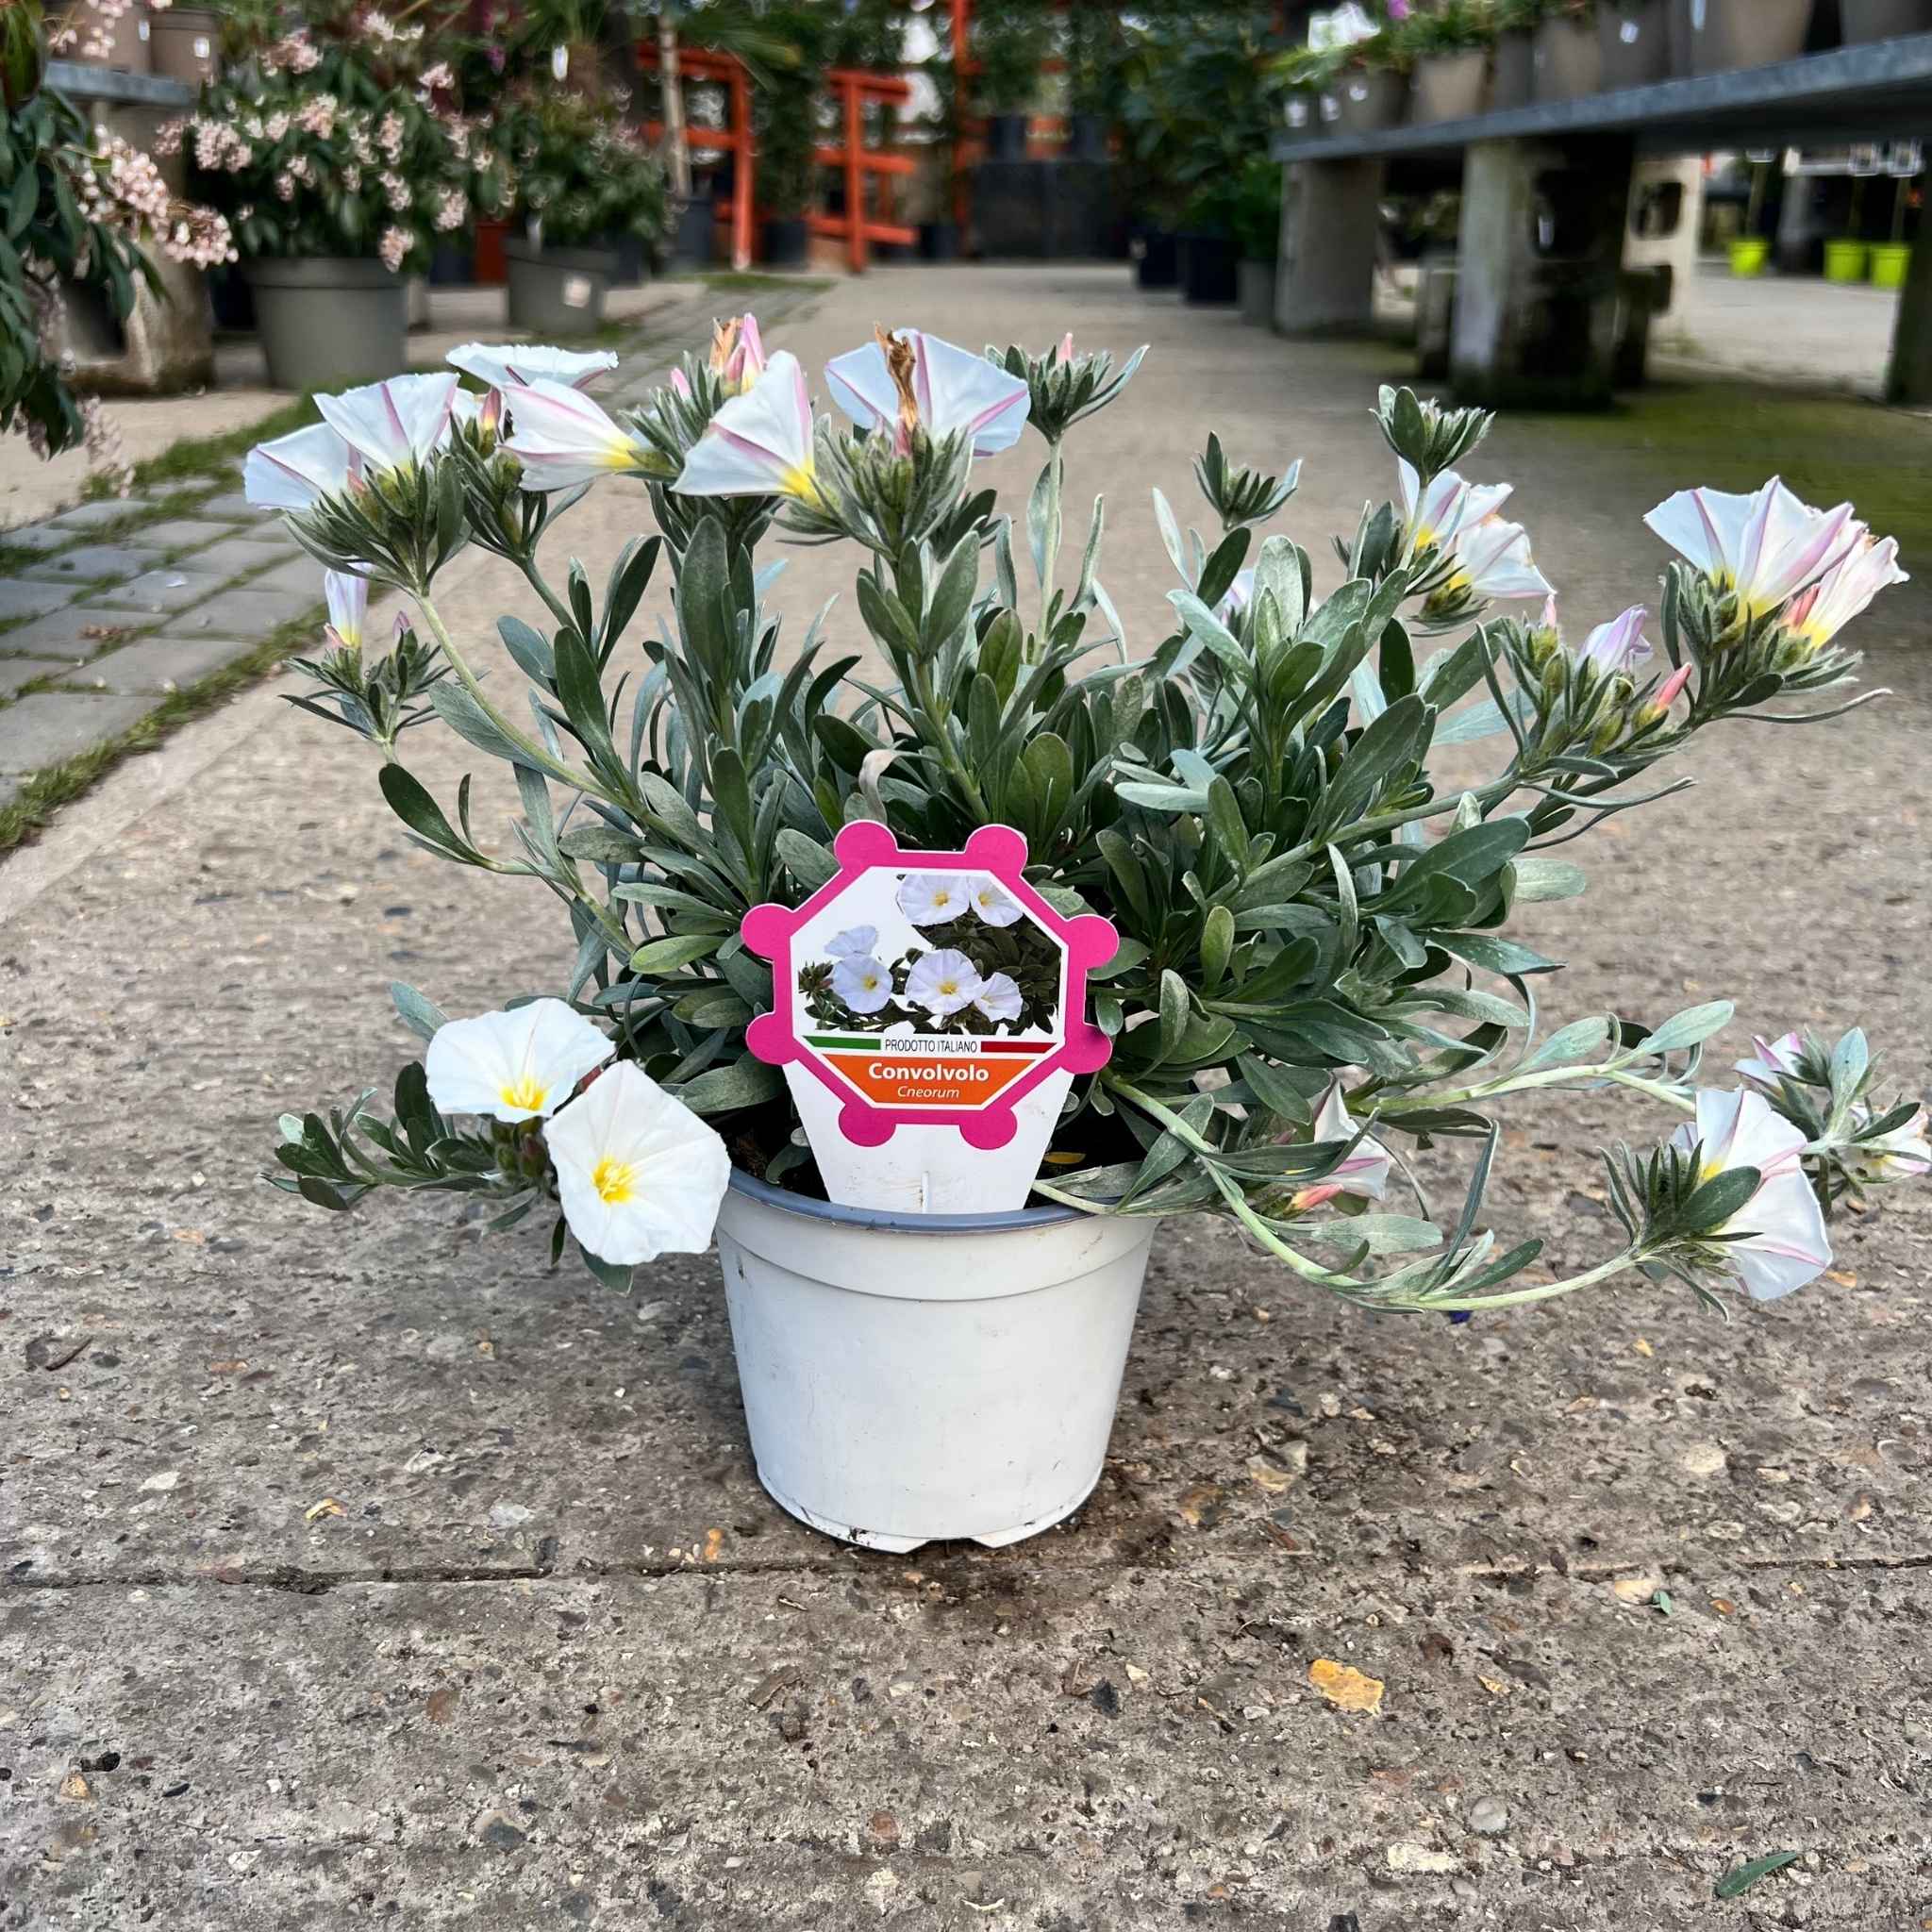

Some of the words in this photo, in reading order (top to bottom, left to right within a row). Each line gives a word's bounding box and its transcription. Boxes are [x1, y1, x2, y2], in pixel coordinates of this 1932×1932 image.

[885, 1039, 936, 1052] PRODOTTO
[937, 1041, 977, 1053] ITALIANO
[868, 1062, 990, 1081] Convolvolo
[897, 1086, 960, 1098] Cneorum
